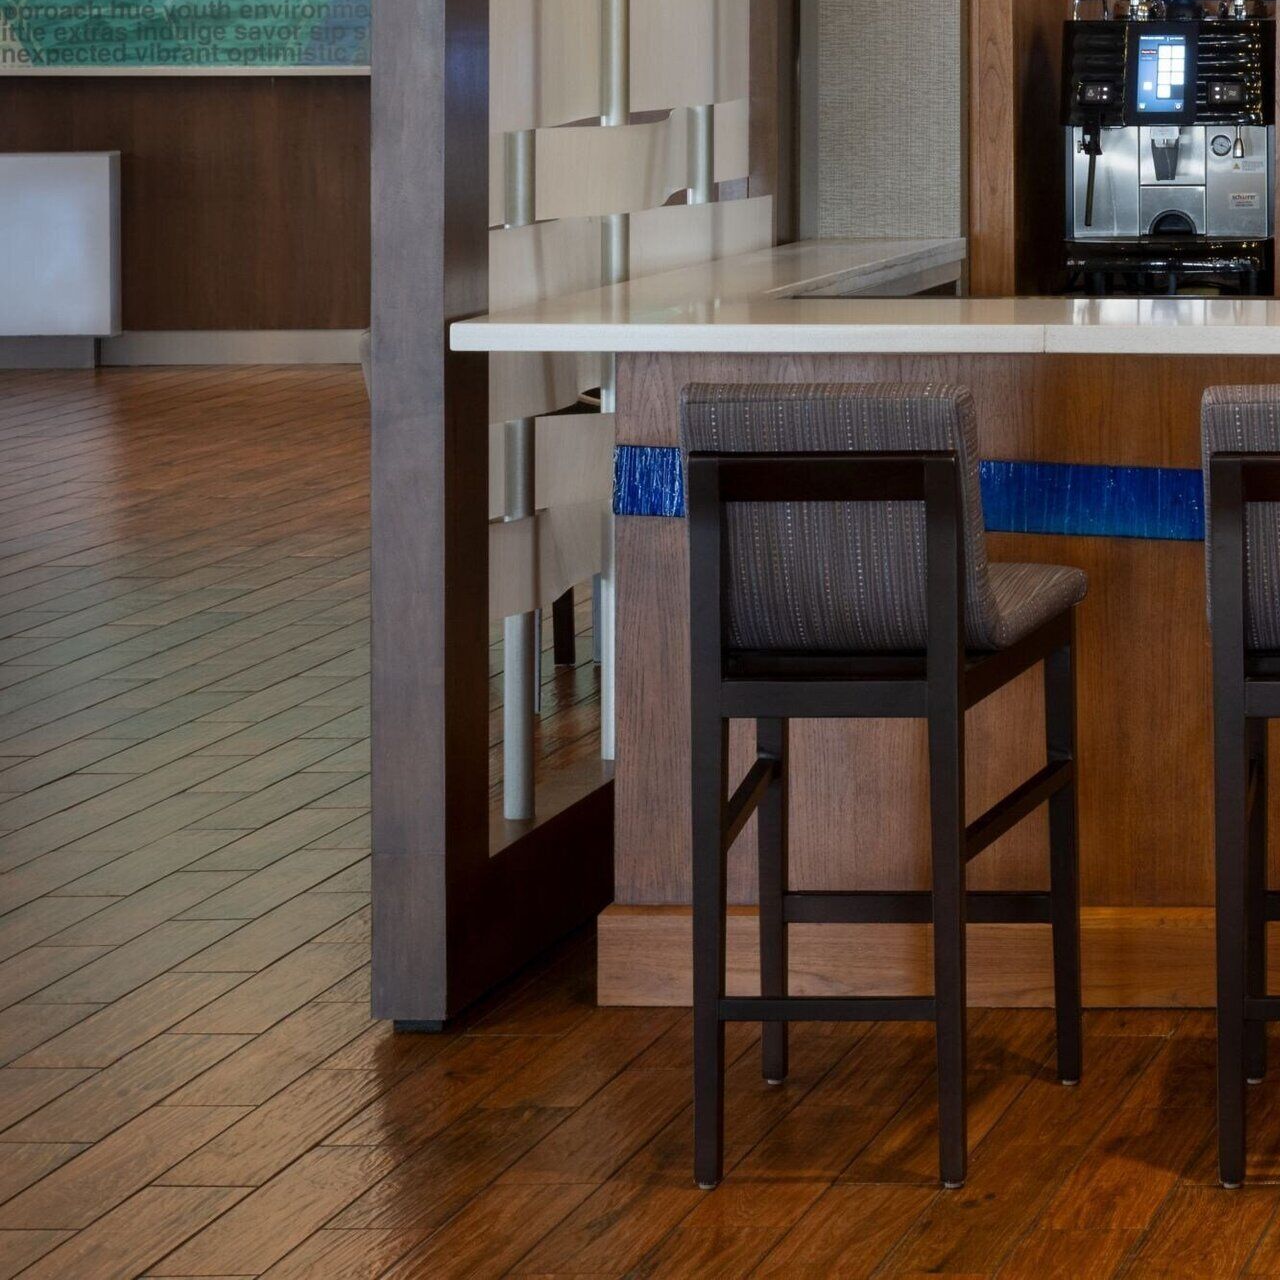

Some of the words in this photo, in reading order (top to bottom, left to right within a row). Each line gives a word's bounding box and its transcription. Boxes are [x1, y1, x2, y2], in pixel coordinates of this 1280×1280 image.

[110, 0, 155, 20] hue
[165, 0, 231, 23] youth
[54, 24, 128, 42] extras
[136, 22, 226, 46] indulge
[234, 25, 302, 41] savor
[310, 23, 347, 44] sip
[135, 43, 220, 63] vibrant
[227, 43, 349, 65] optimistic
